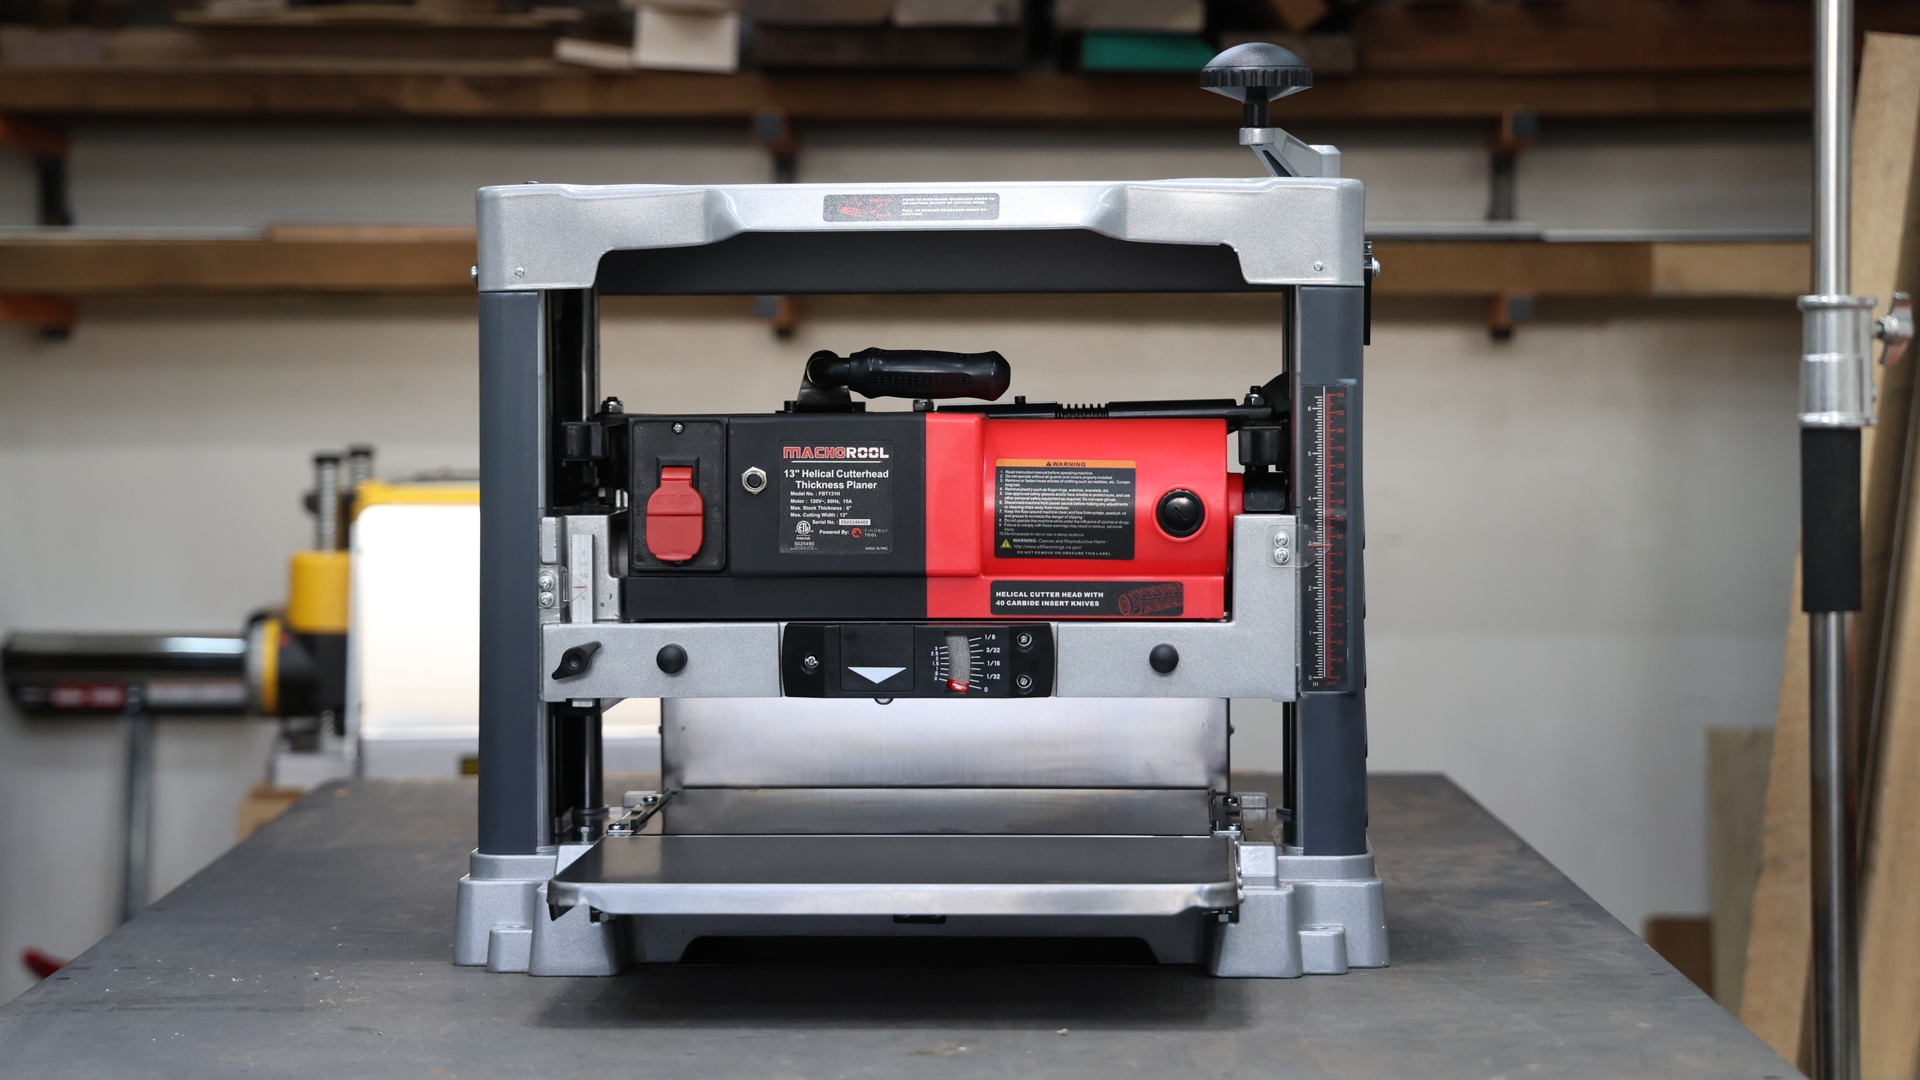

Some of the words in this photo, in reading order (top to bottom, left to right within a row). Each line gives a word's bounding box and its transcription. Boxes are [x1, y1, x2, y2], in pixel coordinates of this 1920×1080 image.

[783, 446, 889, 458] MACHOROOL
[784, 470, 800, 478] 13"
[802, 470, 834, 478] Helical
[836, 470, 889, 478] Cutterhead
[796, 481, 844, 489] Thickness
[847, 481, 877, 489] Planer
